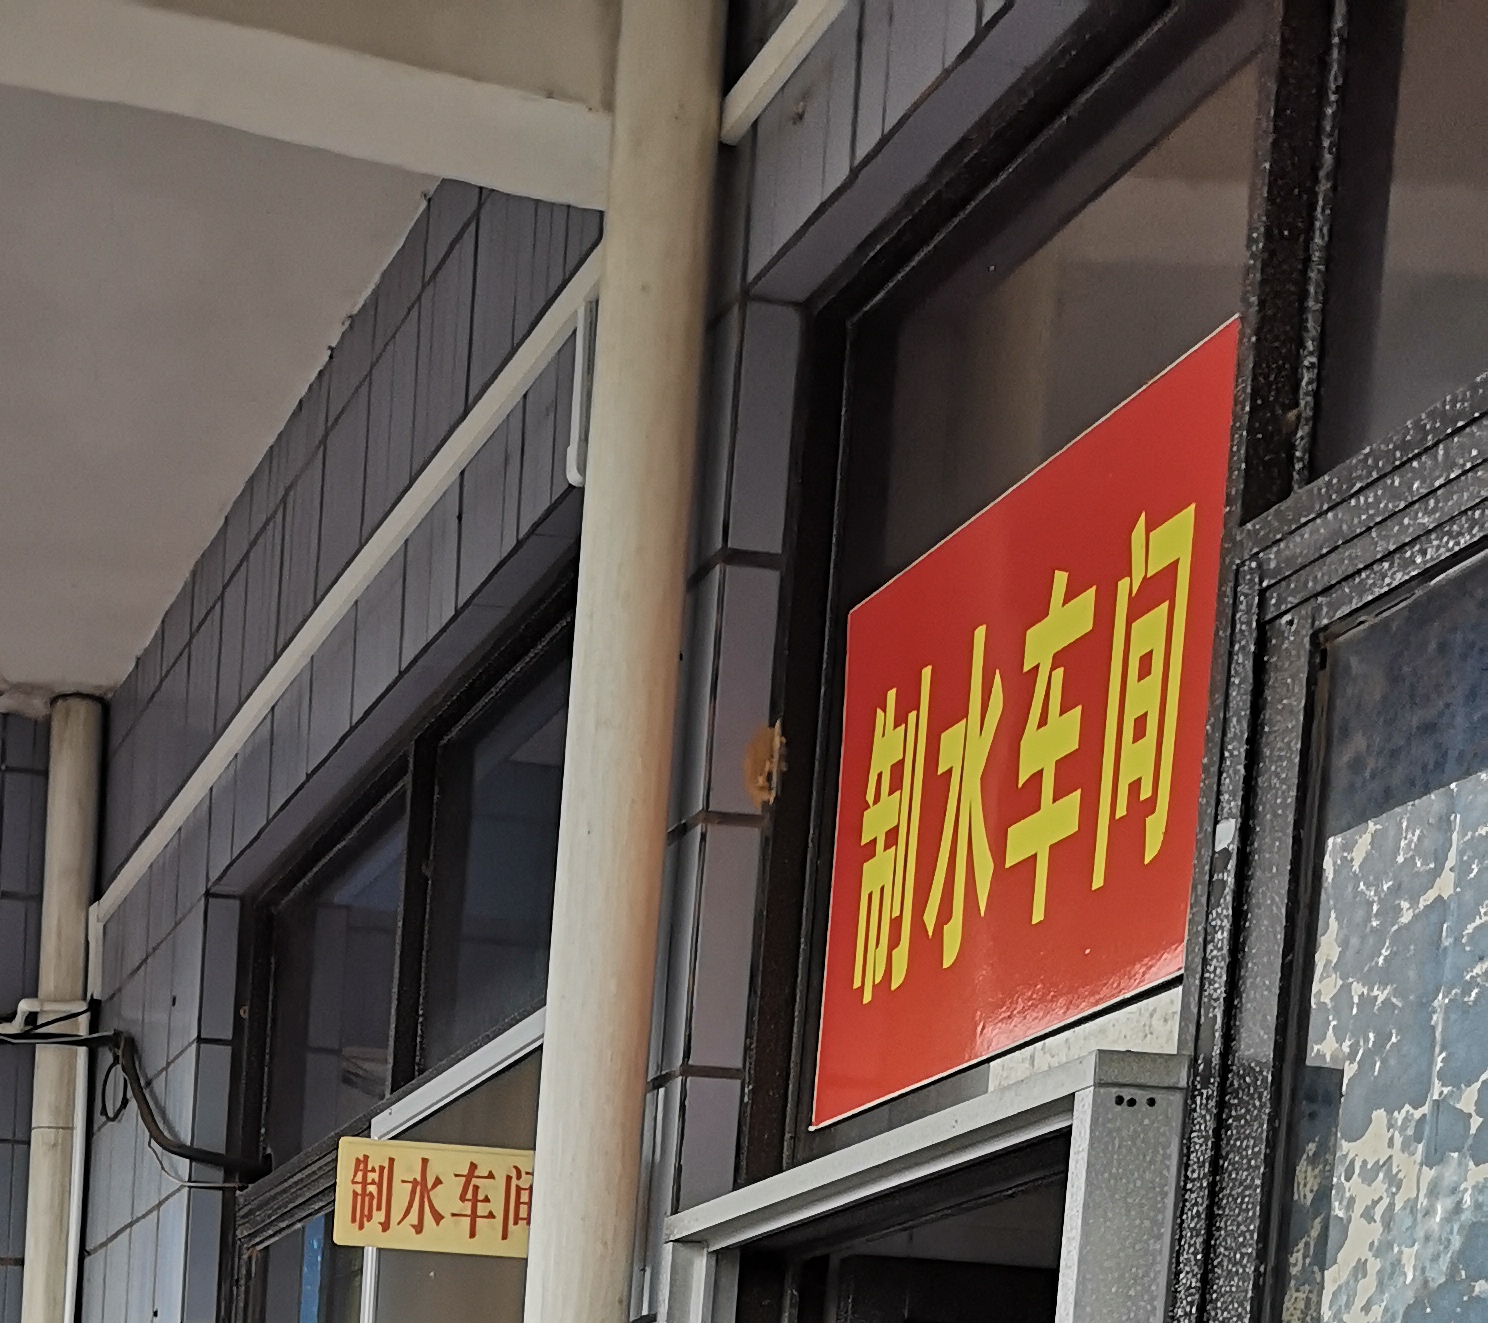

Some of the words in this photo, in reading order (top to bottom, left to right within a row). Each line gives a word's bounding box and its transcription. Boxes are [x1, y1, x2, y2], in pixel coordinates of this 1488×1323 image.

[852, 502, 1197, 1005] 制水车间
[350, 1154, 533, 1241] 制水车间
